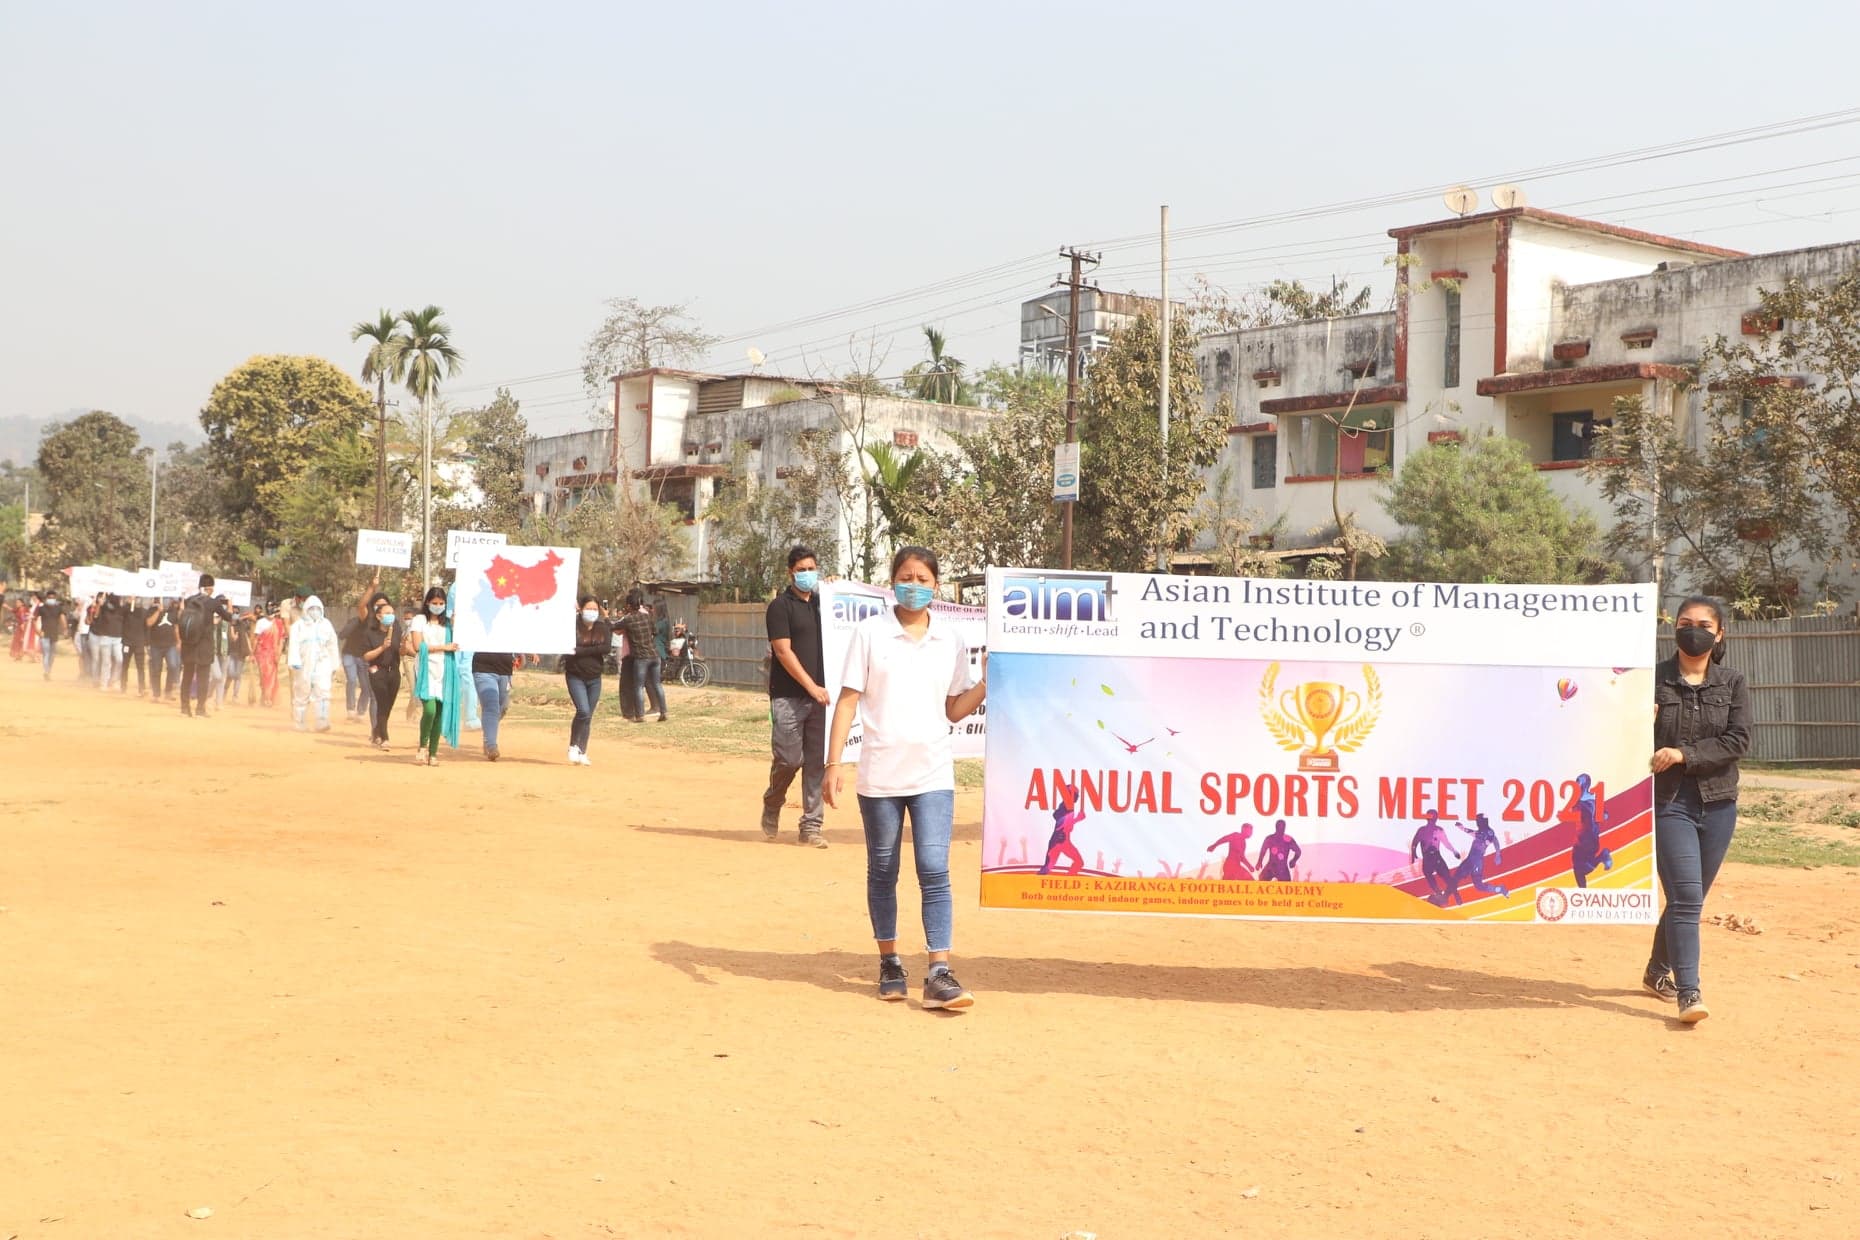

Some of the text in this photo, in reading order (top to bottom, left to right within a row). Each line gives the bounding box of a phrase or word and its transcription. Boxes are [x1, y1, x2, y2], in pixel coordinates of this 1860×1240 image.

[1141, 577, 1645, 618] Asian Institute of Management
[1140, 615, 1199, 641] and
[1211, 616, 1402, 652] Technology
[1025, 768, 1606, 823] ANNUAL SPORTS MEET 2021
[1041, 879, 1081, 890] FIELD
[1094, 880, 1175, 892] KAZIRANGA
[1180, 882, 1253, 895] FOOTBALL
[1256, 885, 1324, 896] ACADEMY
[1021, 891, 1043, 901] Both
[1047, 893, 1084, 902] outdoor
[1087, 894, 1105, 902] and
[1108, 894, 1138, 903] indoor
[1178, 896, 1209, 905] indoor
[1212, 898, 1243, 908] games
[1245, 898, 1255, 906] to
[1257, 898, 1269, 907] be
[1271, 899, 1292, 908] held
[1295, 900, 1305, 908] at
[1308, 900, 1344, 910] College
[1570, 893, 1651, 908] GYANJYOTI
[1571, 910, 1651, 920] FOUNDATION
